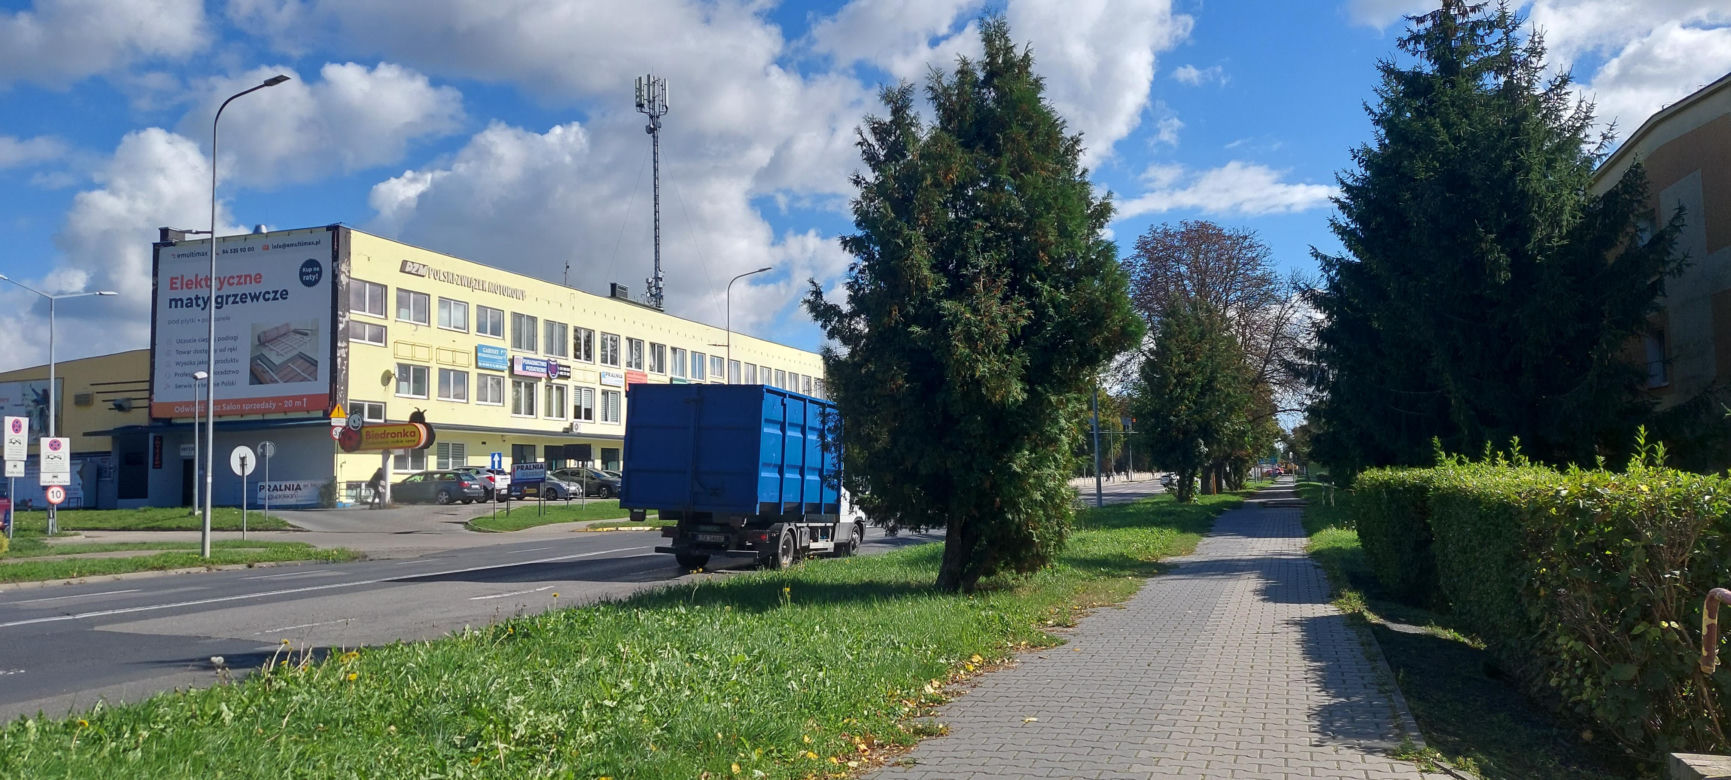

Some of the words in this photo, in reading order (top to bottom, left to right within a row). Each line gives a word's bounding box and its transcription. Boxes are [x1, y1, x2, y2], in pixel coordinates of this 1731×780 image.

[168, 294, 210, 311] maty
[214, 288, 289, 310] grzewcze
[222, 403, 241, 411] Salon
[516, 463, 544, 471] PRALNIA
[259, 484, 302, 493] PRALNIA
[50, 490, 62, 499] 10
